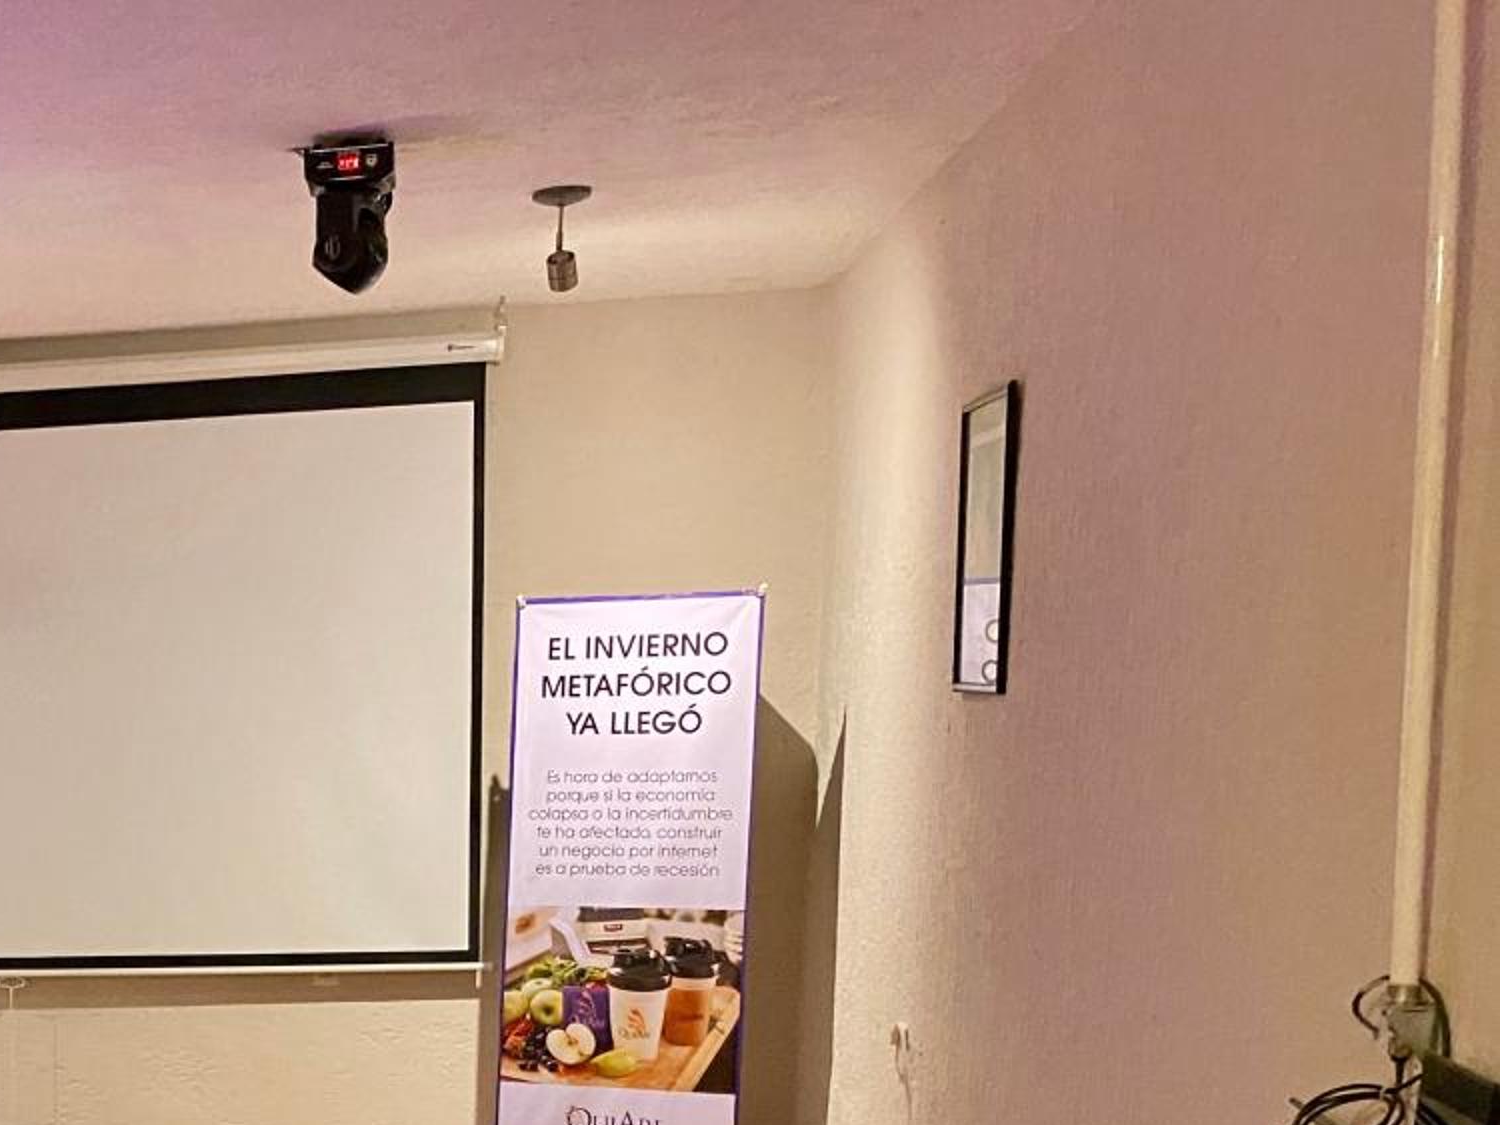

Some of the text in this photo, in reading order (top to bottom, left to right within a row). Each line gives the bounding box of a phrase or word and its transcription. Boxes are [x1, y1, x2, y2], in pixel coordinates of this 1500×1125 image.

[548, 631, 729, 661] EL INVIERNO
[541, 665, 731, 698] METAFÓRICO
[566, 703, 703, 735] YA LLEGÓ
[547, 769, 560, 784] Es
[564, 771, 598, 783] hora
[602, 770, 623, 783] de
[546, 788, 715, 804] porque si la economía
[528, 806, 733, 822] colapsa o la incertidumbre
[537, 826, 551, 839] te
[555, 825, 575, 839] ha
[657, 826, 722, 840] construir
[539, 844, 718, 860] un negocio por internet
[536, 864, 551, 875] es
[556, 864, 567, 875] a
[570, 863, 627, 877] prueba
[630, 864, 651, 877] de
